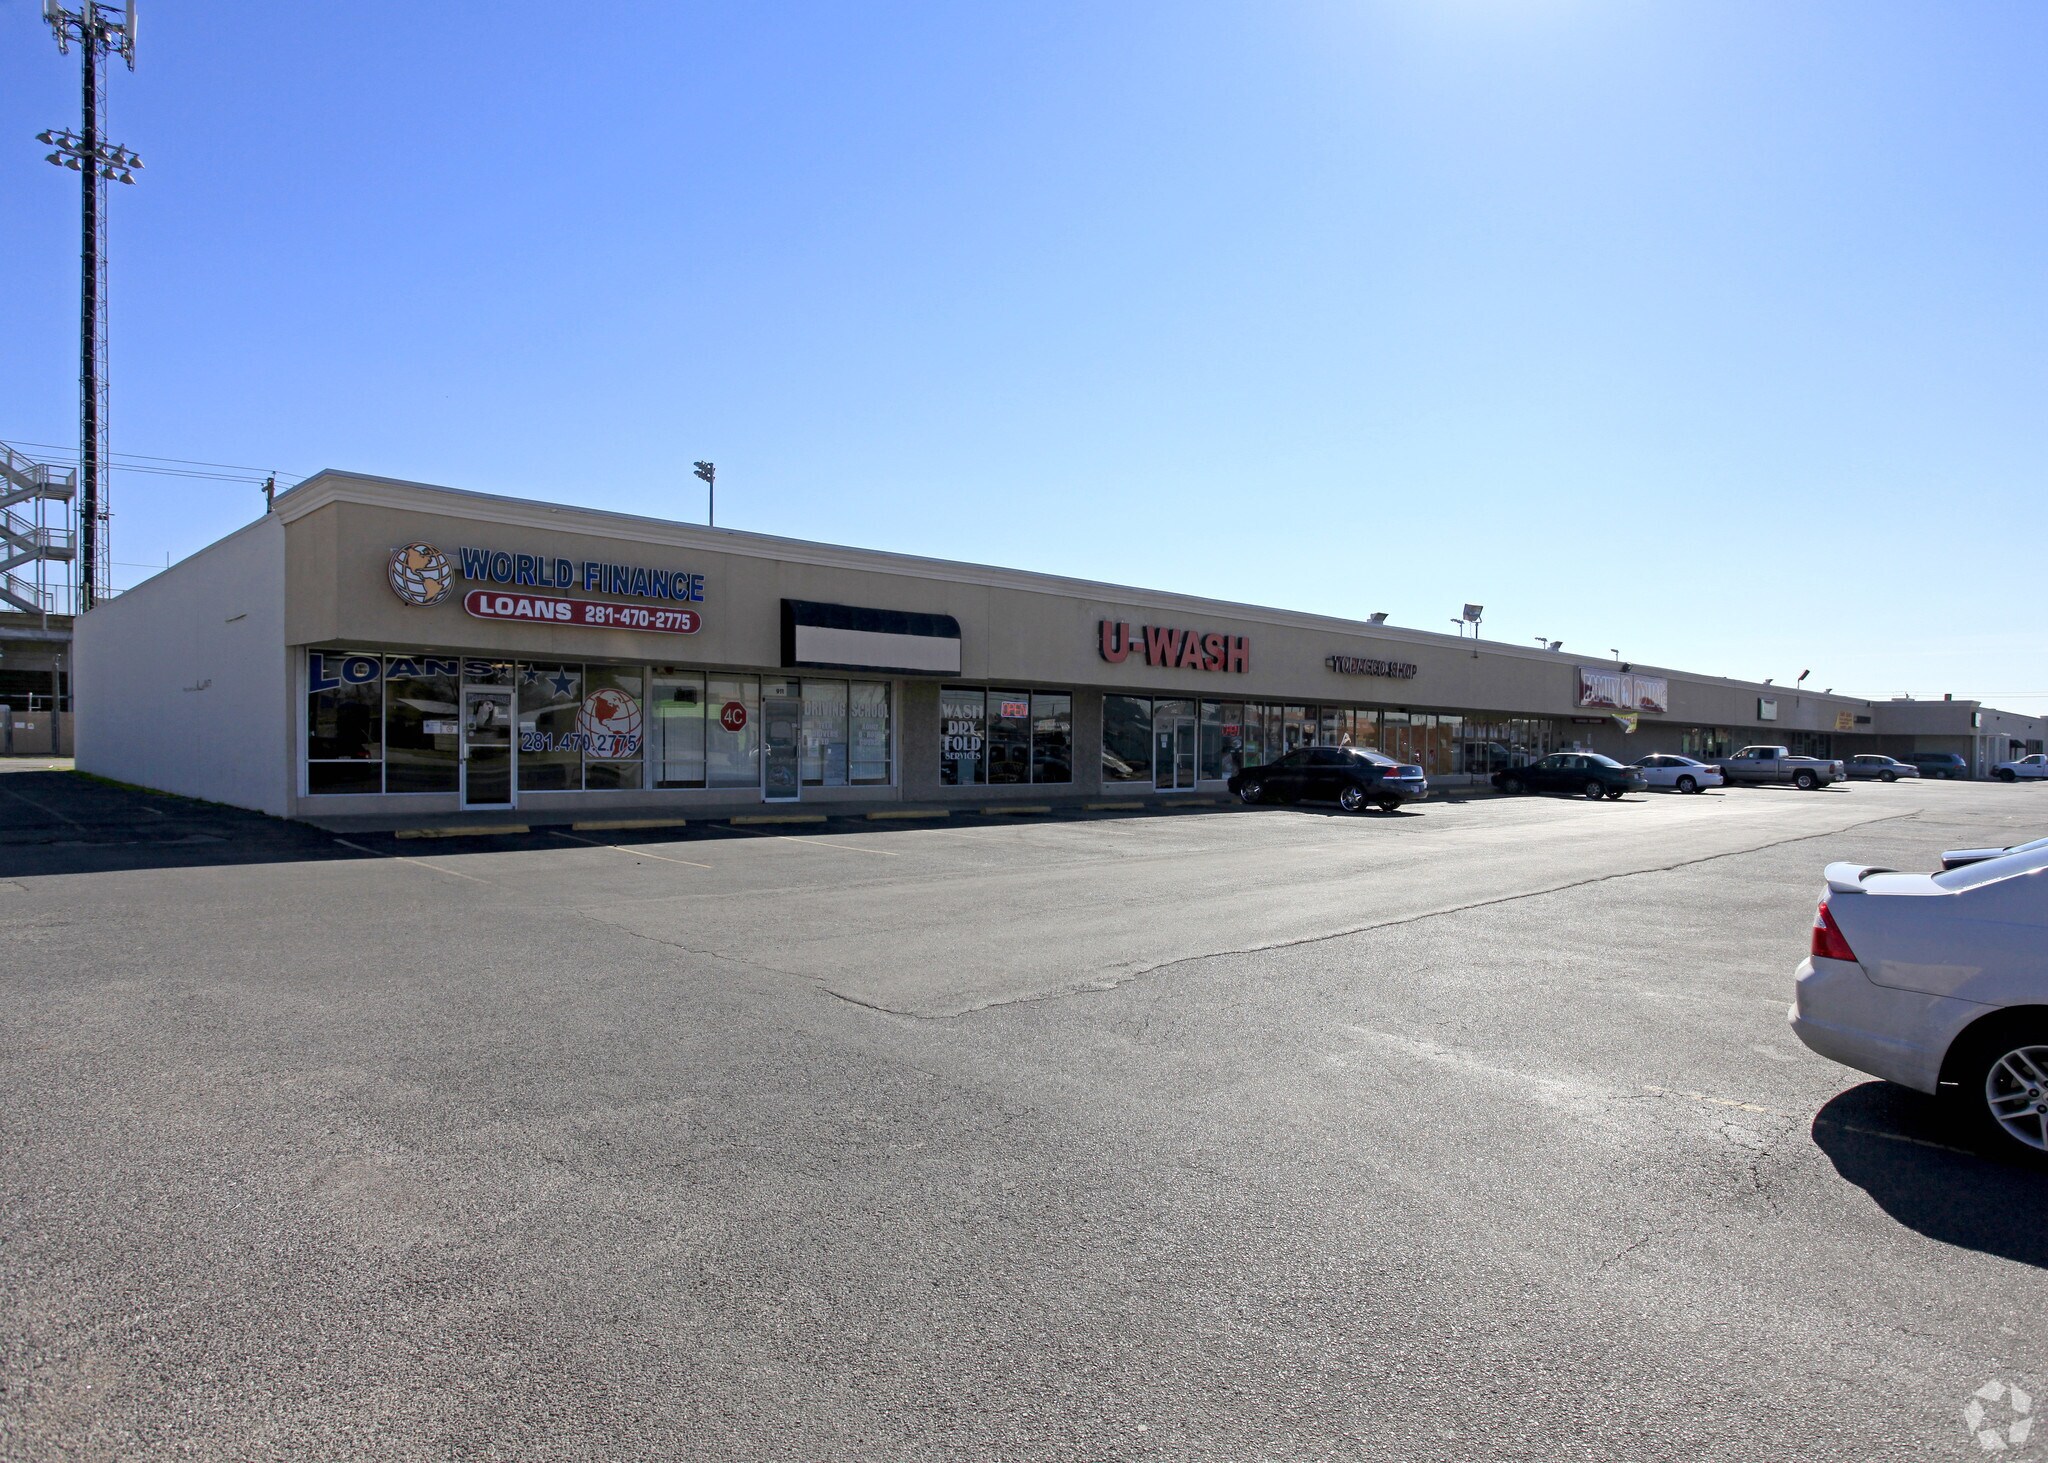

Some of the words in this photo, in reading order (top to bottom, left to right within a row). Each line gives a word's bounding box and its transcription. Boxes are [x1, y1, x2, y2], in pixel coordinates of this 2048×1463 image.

[460, 547, 575, 588] WORLD
[583, 561, 705, 602] FINANCE
[479, 595, 572, 620] LOANS
[585, 605, 690, 631] 281-470-2775
[1098, 620, 1249, 673] U-WASH
[309, 653, 494, 693] LOANS
[1332, 656, 1386, 676] TOBACCO
[1388, 661, 1417, 679] SHOP
[724, 709, 743, 724] 4C
[804, 700, 846, 717] DRIVING
[851, 702, 889, 718] SCHOOL
[942, 704, 984, 719] WASH
[1002, 703, 1027, 717] OPEN
[948, 720, 976, 735] DRY
[522, 732, 637, 752] 281.470.2775
[944, 736, 981, 751] FOLD
[945, 752, 981, 760] SERVICES
